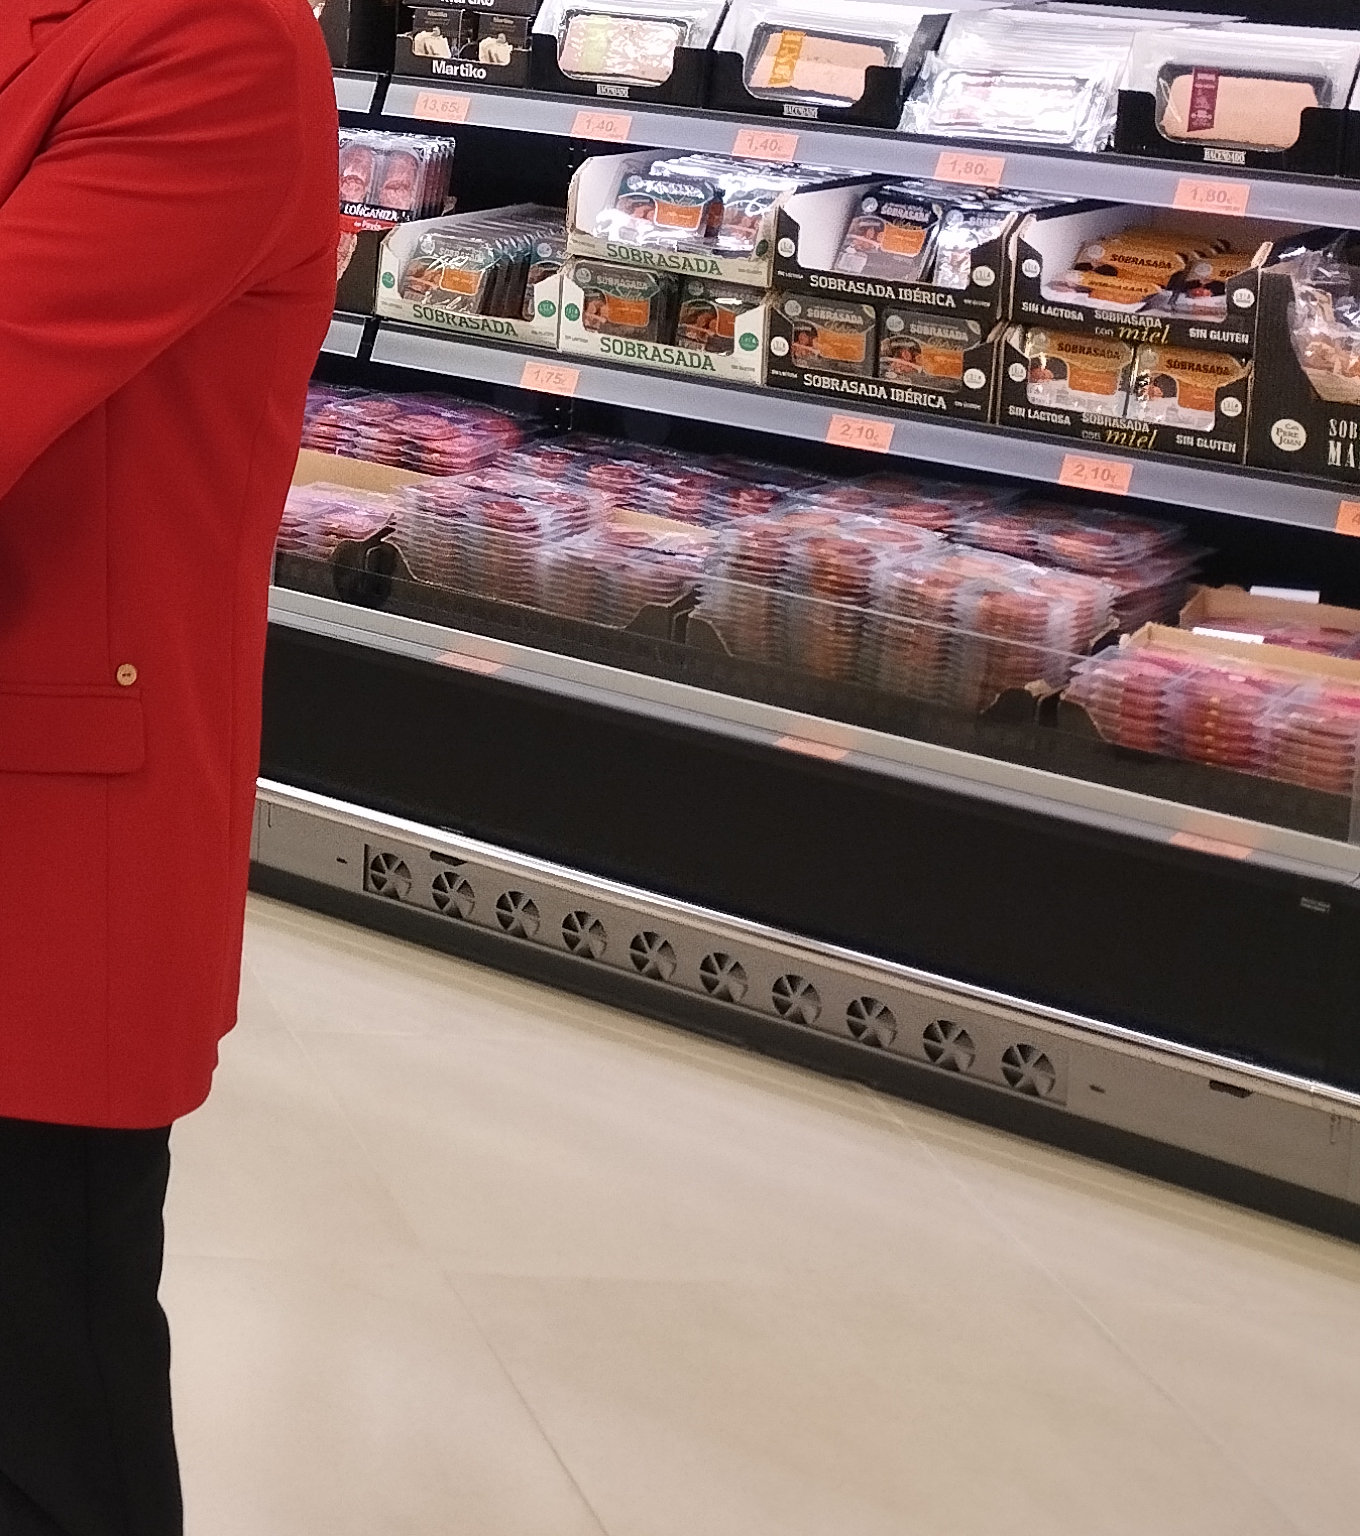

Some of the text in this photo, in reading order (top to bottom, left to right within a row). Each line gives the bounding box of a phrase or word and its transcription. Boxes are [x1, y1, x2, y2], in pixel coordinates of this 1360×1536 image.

[432, 59, 487, 80] Martiko
[606, 243, 723, 276] SOBRASADA
[1109, 253, 1173, 270] SOBRASADA
[809, 274, 895, 300] SOBRASADA
[898, 286, 956, 309] IBÉRICA
[412, 304, 519, 338] SOBRASADA
[806, 307, 864, 325] SOBRASADA
[1021, 301, 1084, 322] SIN LACTOSA
[1094, 309, 1162, 329] SOBRASADA
[909, 323, 969, 342] SOBRASADA
[1094, 324, 1171, 345] con miel
[1189, 327, 1249, 345] SIN GLUTEN
[600, 336, 716, 372] SOBRASADA
[1057, 341, 1121, 360] SOBRASADA
[1165, 359, 1231, 376] SOBRASADA
[803, 373, 947, 410] SOBRASADA IBÉRICA
[1008, 405, 1072, 426] SIN LACTOSA
[1081, 413, 1150, 433] SOBRASADA
[1081, 428, 1158, 450] con miel
[1328, 418, 1360, 440] SOB
[1175, 434, 1237, 453] SIN GLUTEN
[1328, 439, 1360, 470] MA
